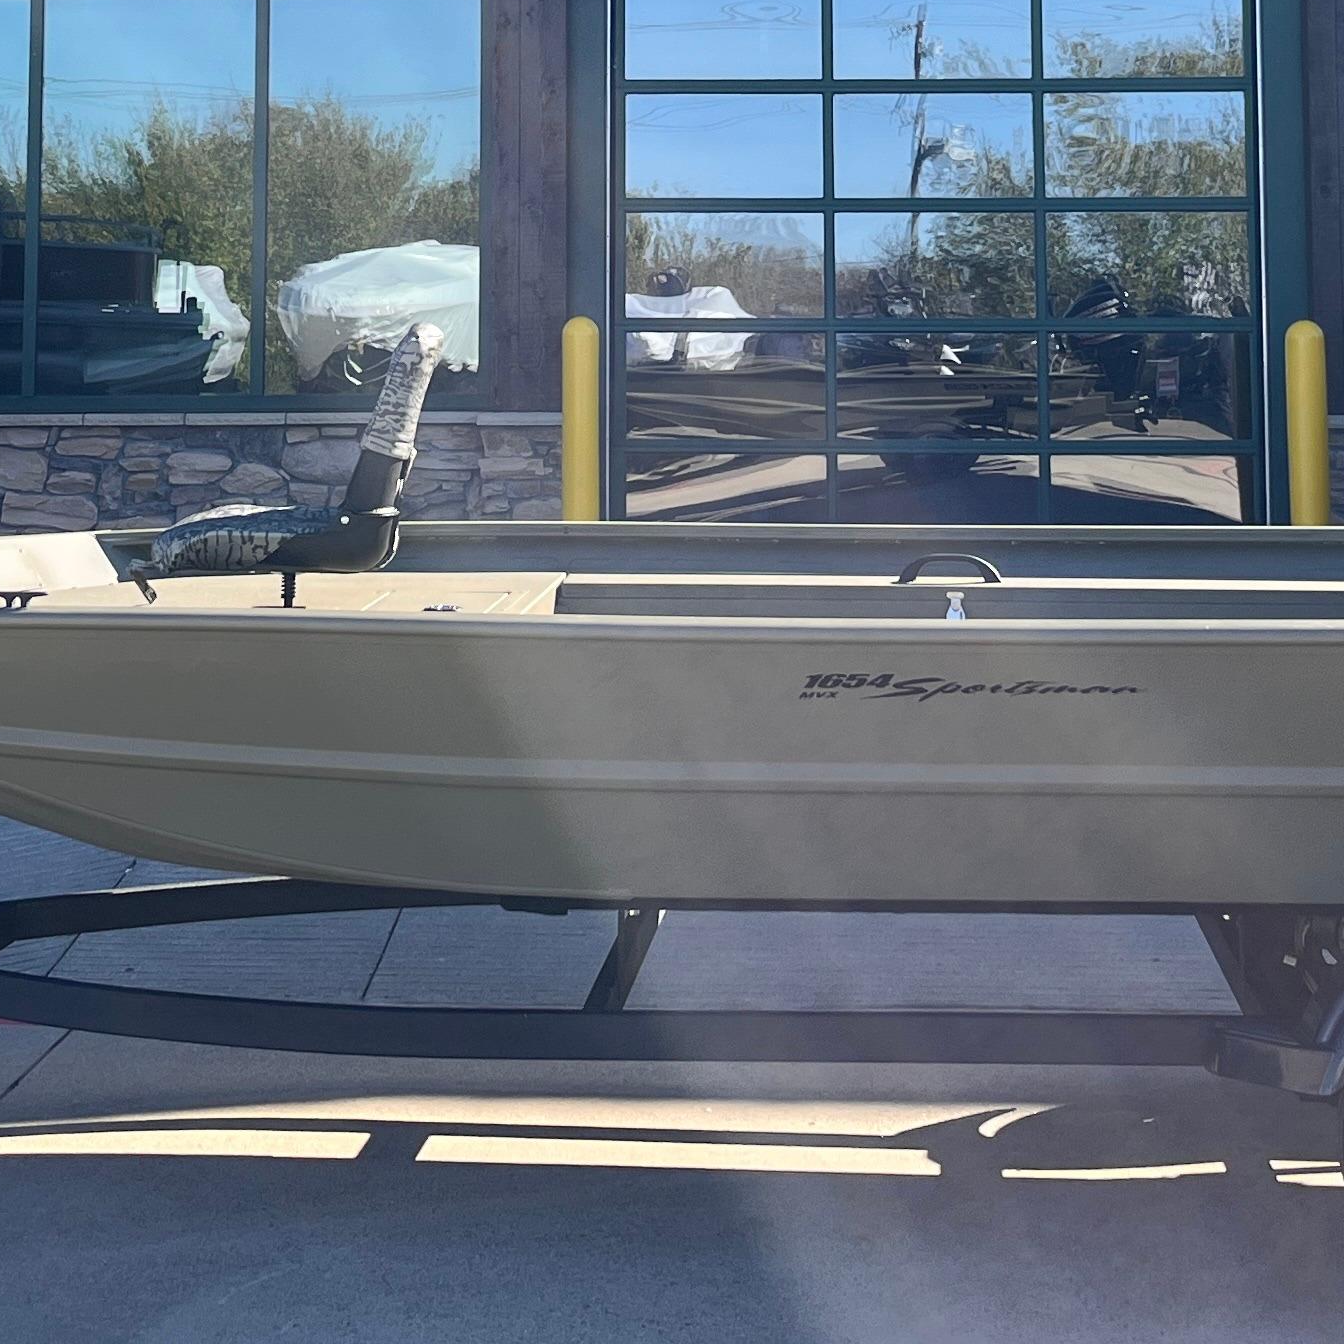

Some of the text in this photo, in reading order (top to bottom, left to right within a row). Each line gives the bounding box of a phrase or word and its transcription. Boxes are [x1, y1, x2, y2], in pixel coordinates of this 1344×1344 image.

[799, 691, 839, 700] MVX
[803, 673, 1142, 703] 1654 Sportsman
